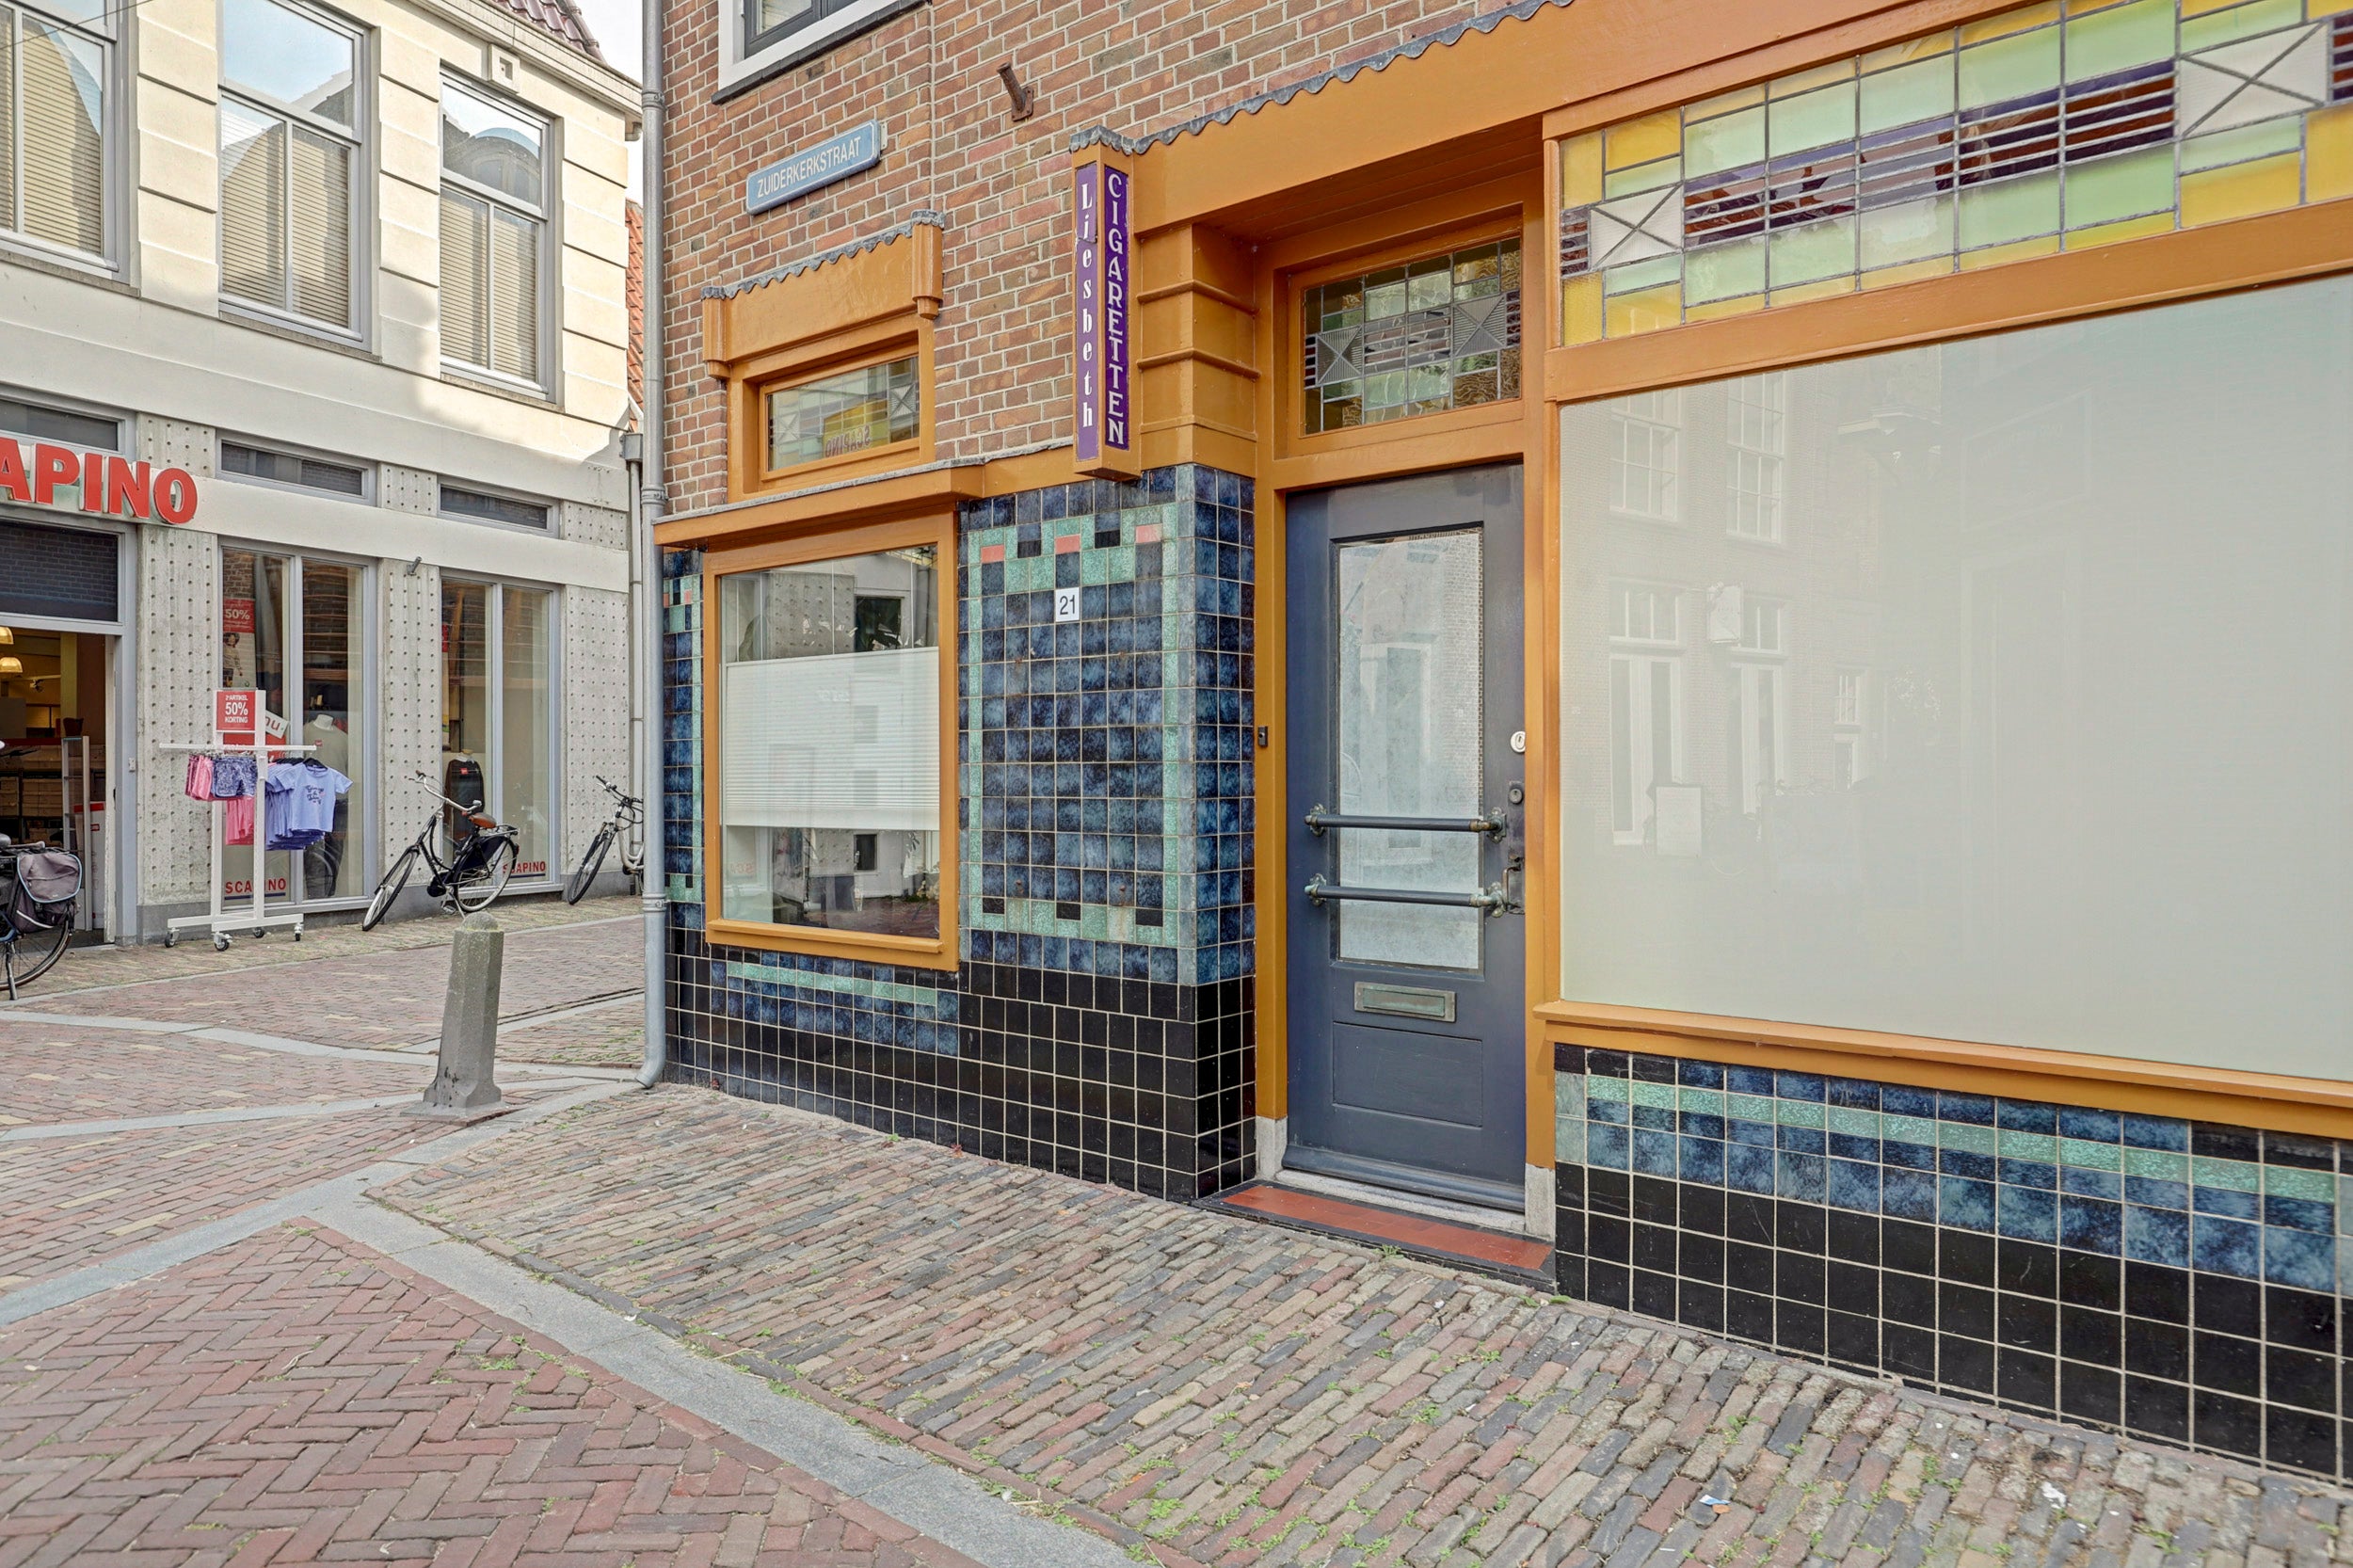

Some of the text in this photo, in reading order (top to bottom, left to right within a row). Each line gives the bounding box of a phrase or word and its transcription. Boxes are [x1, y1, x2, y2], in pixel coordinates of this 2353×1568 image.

[757, 136, 861, 199] ZUIDERKERKSTRAAT
[1081, 183, 1094, 428] Liesbeth
[1108, 173, 1125, 445] CIGARETTEN
[225, 608, 251, 620] 50%
[1060, 594, 1076, 616] 21
[225, 701, 248, 716] 50%
[225, 878, 286, 894] SCANO
